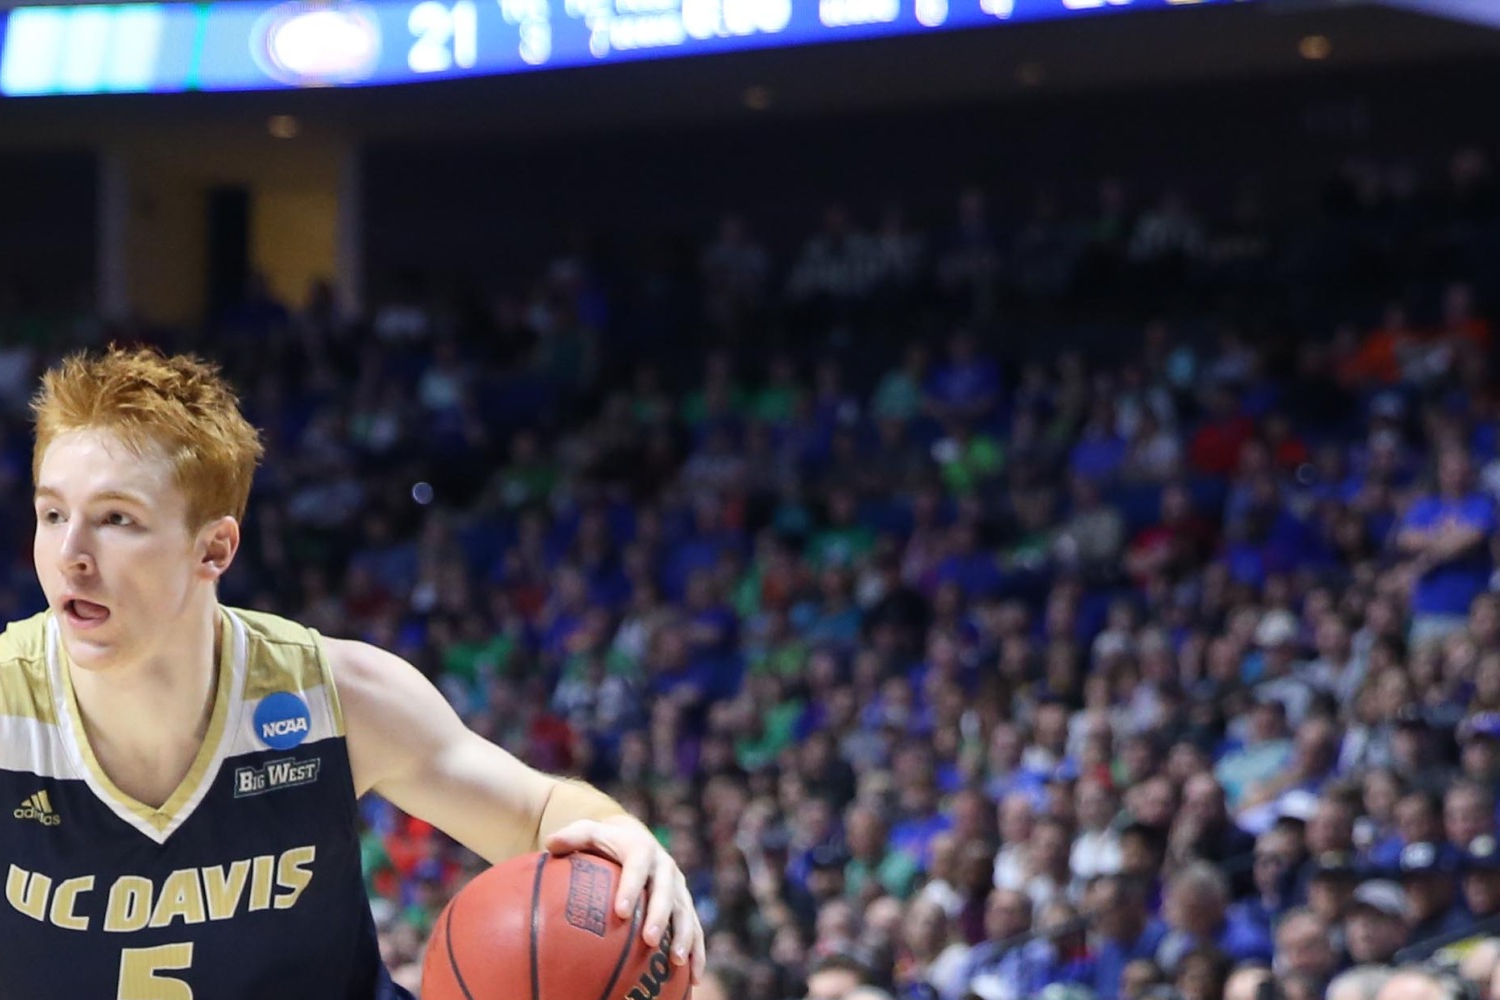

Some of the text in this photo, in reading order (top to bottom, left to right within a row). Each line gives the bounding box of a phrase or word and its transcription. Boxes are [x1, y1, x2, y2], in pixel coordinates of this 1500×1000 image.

[408, 1, 478, 73] 21
[262, 717, 308, 739] NCAA
[13, 807, 61, 826] adidas
[5, 845, 317, 932] UC DAVIS
